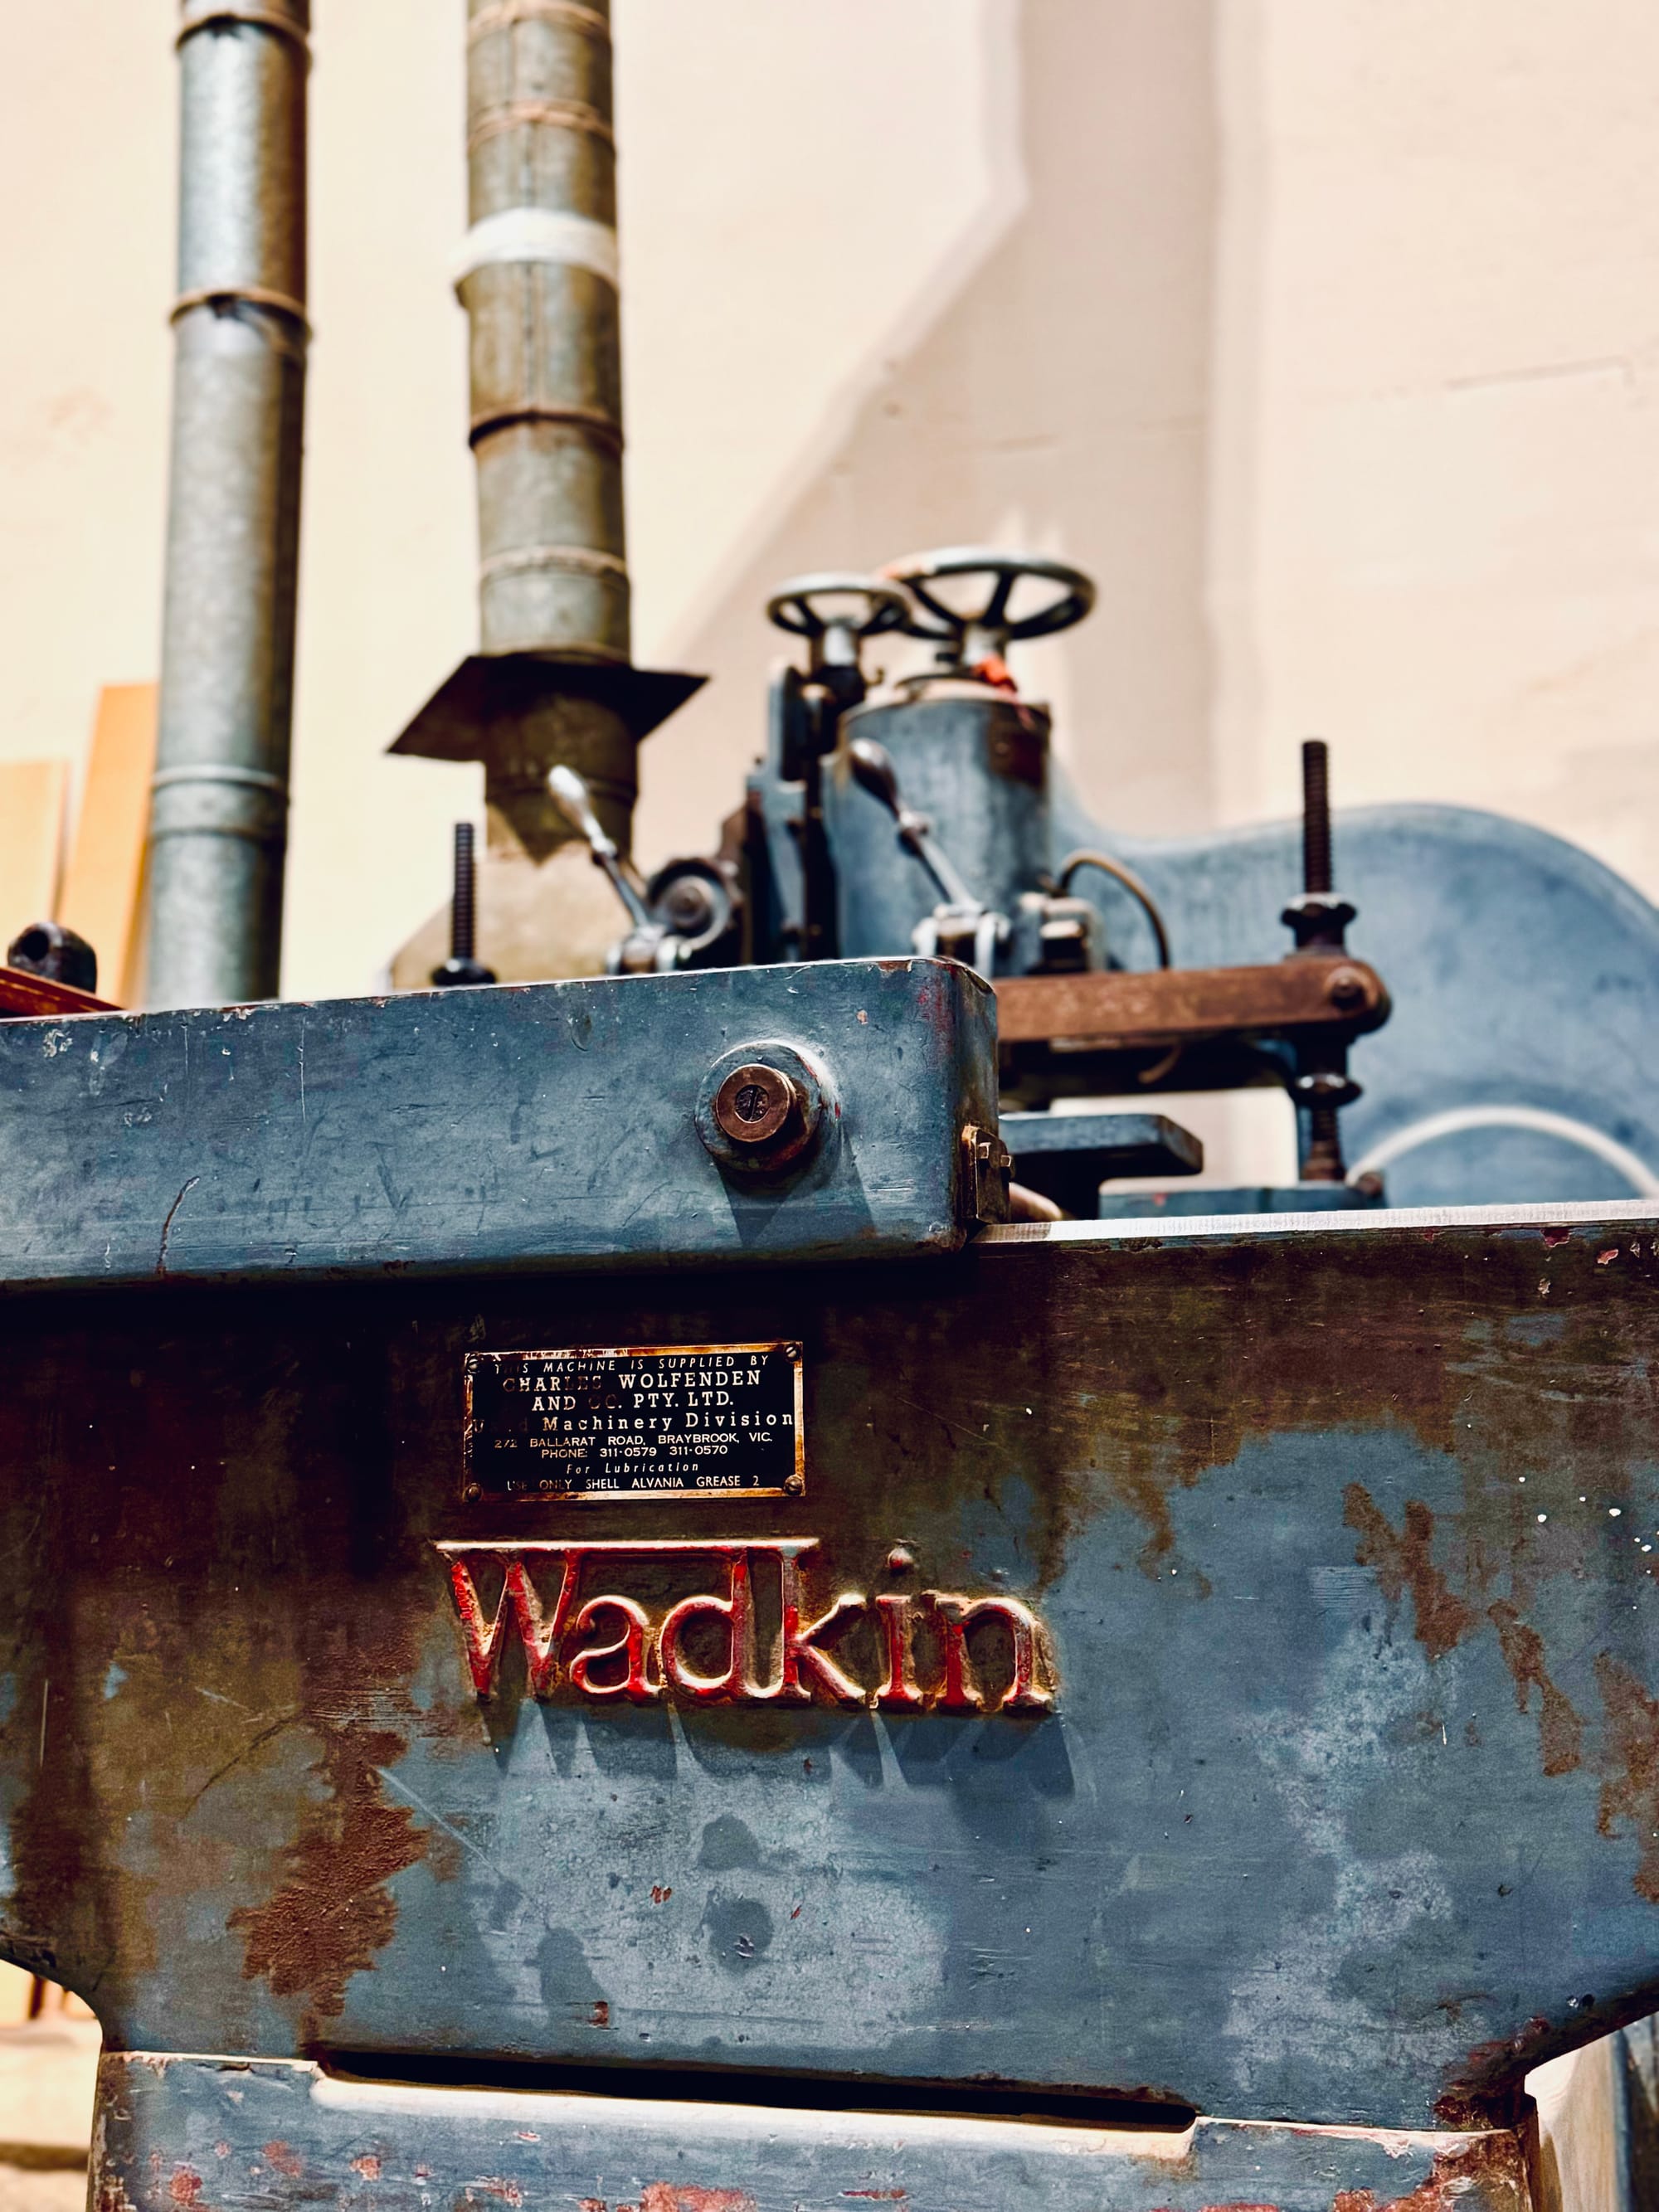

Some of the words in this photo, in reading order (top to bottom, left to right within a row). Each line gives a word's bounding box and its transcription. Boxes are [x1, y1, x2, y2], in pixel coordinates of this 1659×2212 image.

[543, 1360, 615, 1373] MACHINE
[630, 1359, 644, 1370] IS
[659, 1355, 735, 1369] SUPPLIED
[750, 1354, 769, 1366] BY
[503, 1375, 602, 1393] CHARLES
[618, 1369, 761, 1390] WOLFENDEN
[531, 1395, 577, 1412] AND
[633, 1392, 679, 1408] PTY.
[688, 1390, 734, 1407] LTD.
[542, 1415, 673, 1432] Machinery
[685, 1411, 793, 1428] Division
[529, 1436, 596, 1448] BALLARAT
[658, 1432, 740, 1445] BRAYBROOK,
[748, 1432, 773, 1442] VIC.
[566, 1463, 591, 1475] For
[605, 1462, 698, 1474] Lubrication
[585, 1478, 620, 1490] SHELL
[631, 1476, 684, 1489] ALVANIA
[696, 1475, 741, 1487] GREASE
[752, 1475, 761, 1486] 2
[435, 1538, 1054, 1714] Wadkin
